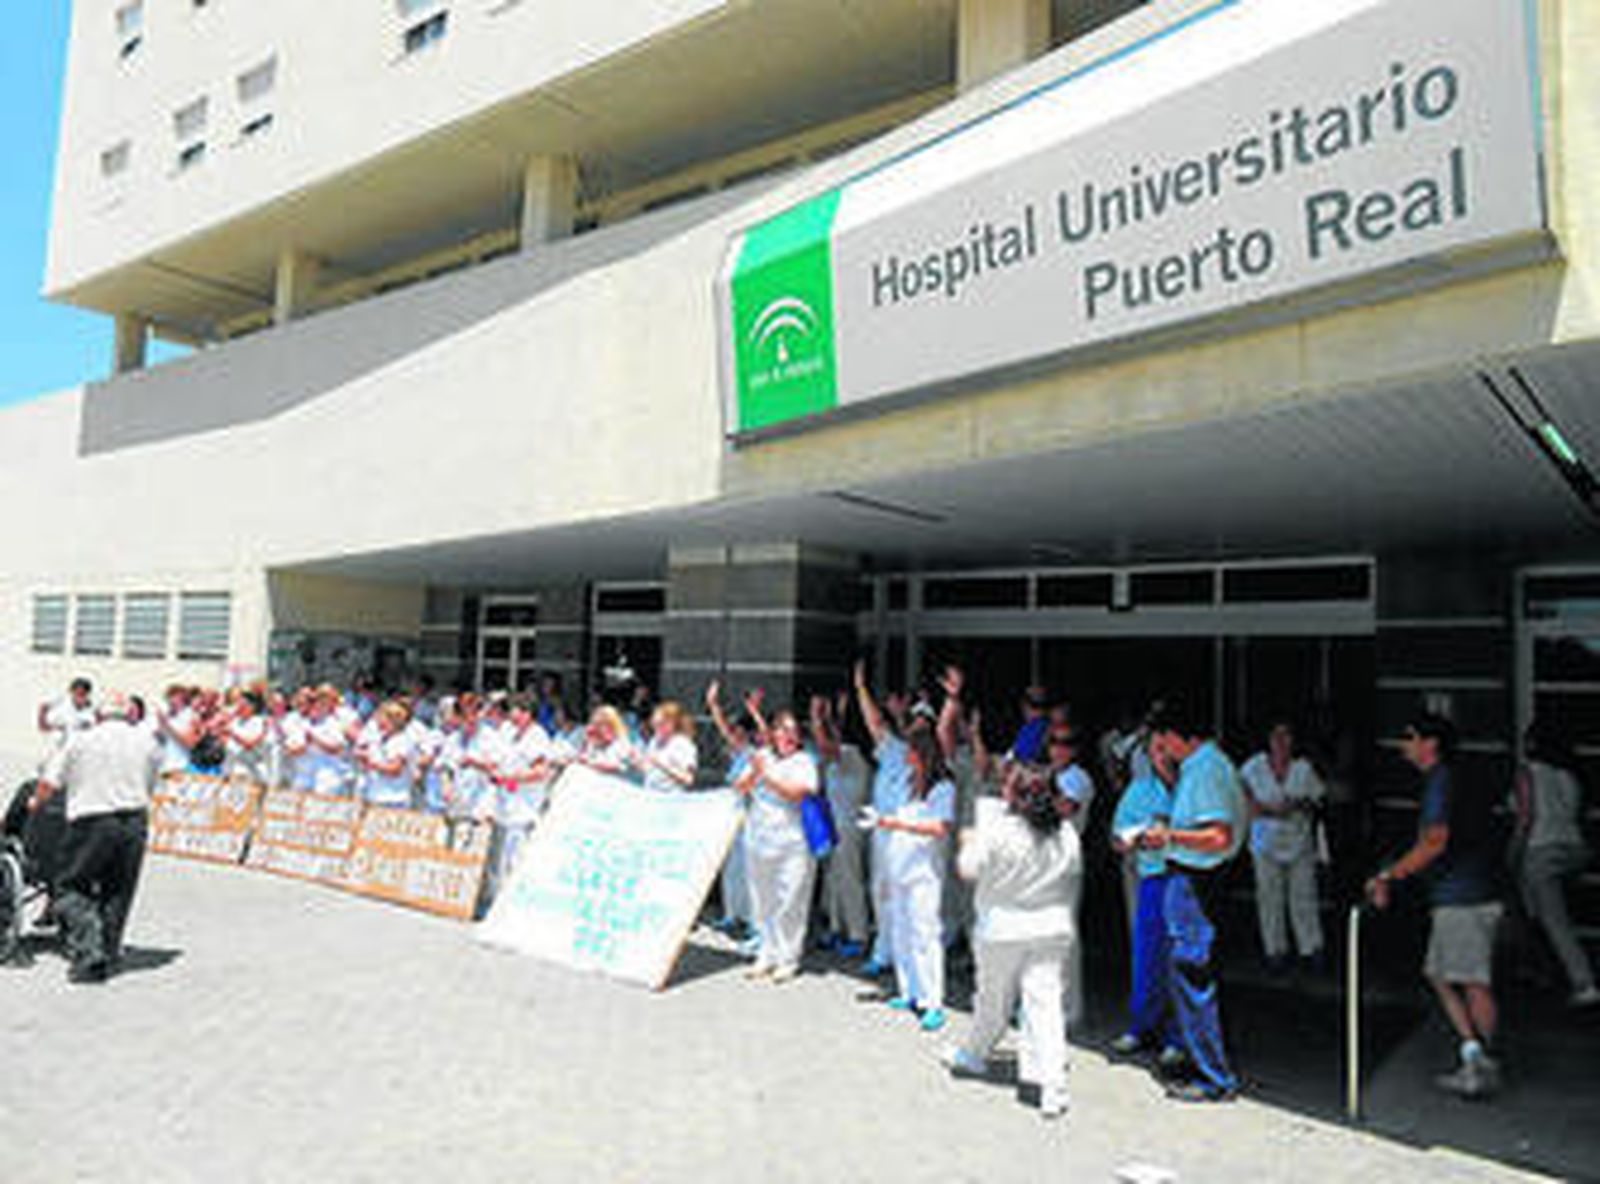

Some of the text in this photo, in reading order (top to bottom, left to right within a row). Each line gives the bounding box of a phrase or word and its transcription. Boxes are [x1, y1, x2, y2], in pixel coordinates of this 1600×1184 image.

[871, 62, 1458, 307] Hospital Universitario
[1083, 147, 1468, 319] Puerto Real
